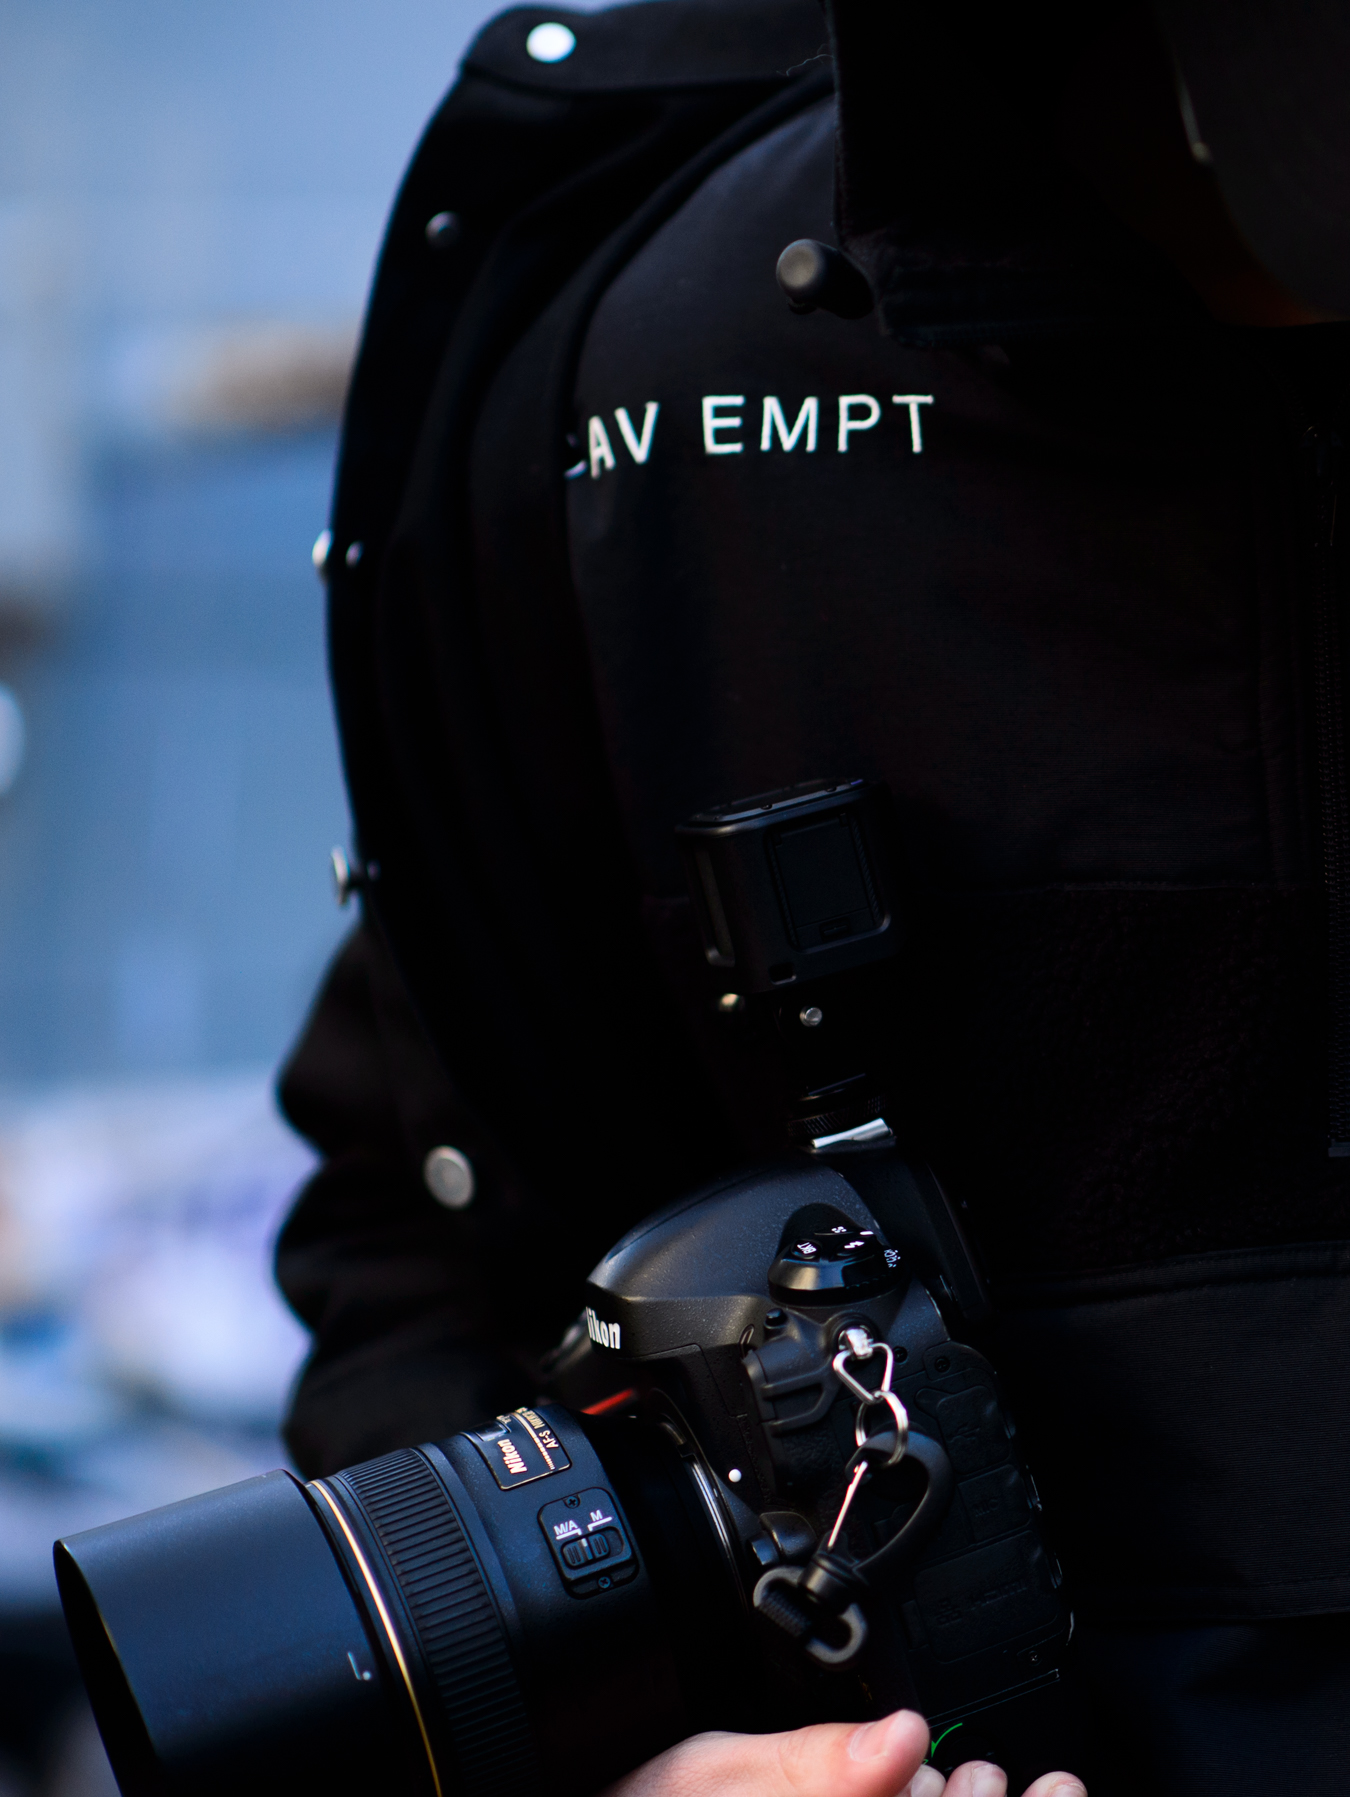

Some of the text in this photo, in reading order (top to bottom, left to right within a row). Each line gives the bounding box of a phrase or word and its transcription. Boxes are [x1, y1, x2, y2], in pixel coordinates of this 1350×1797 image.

[702, 394, 934, 454] EMPT
[585, 1306, 621, 1350] ikon
[497, 1438, 528, 1475] Nikon
[539, 1430, 559, 1449] AF-S
[553, 1509, 603, 1536] M/A M
